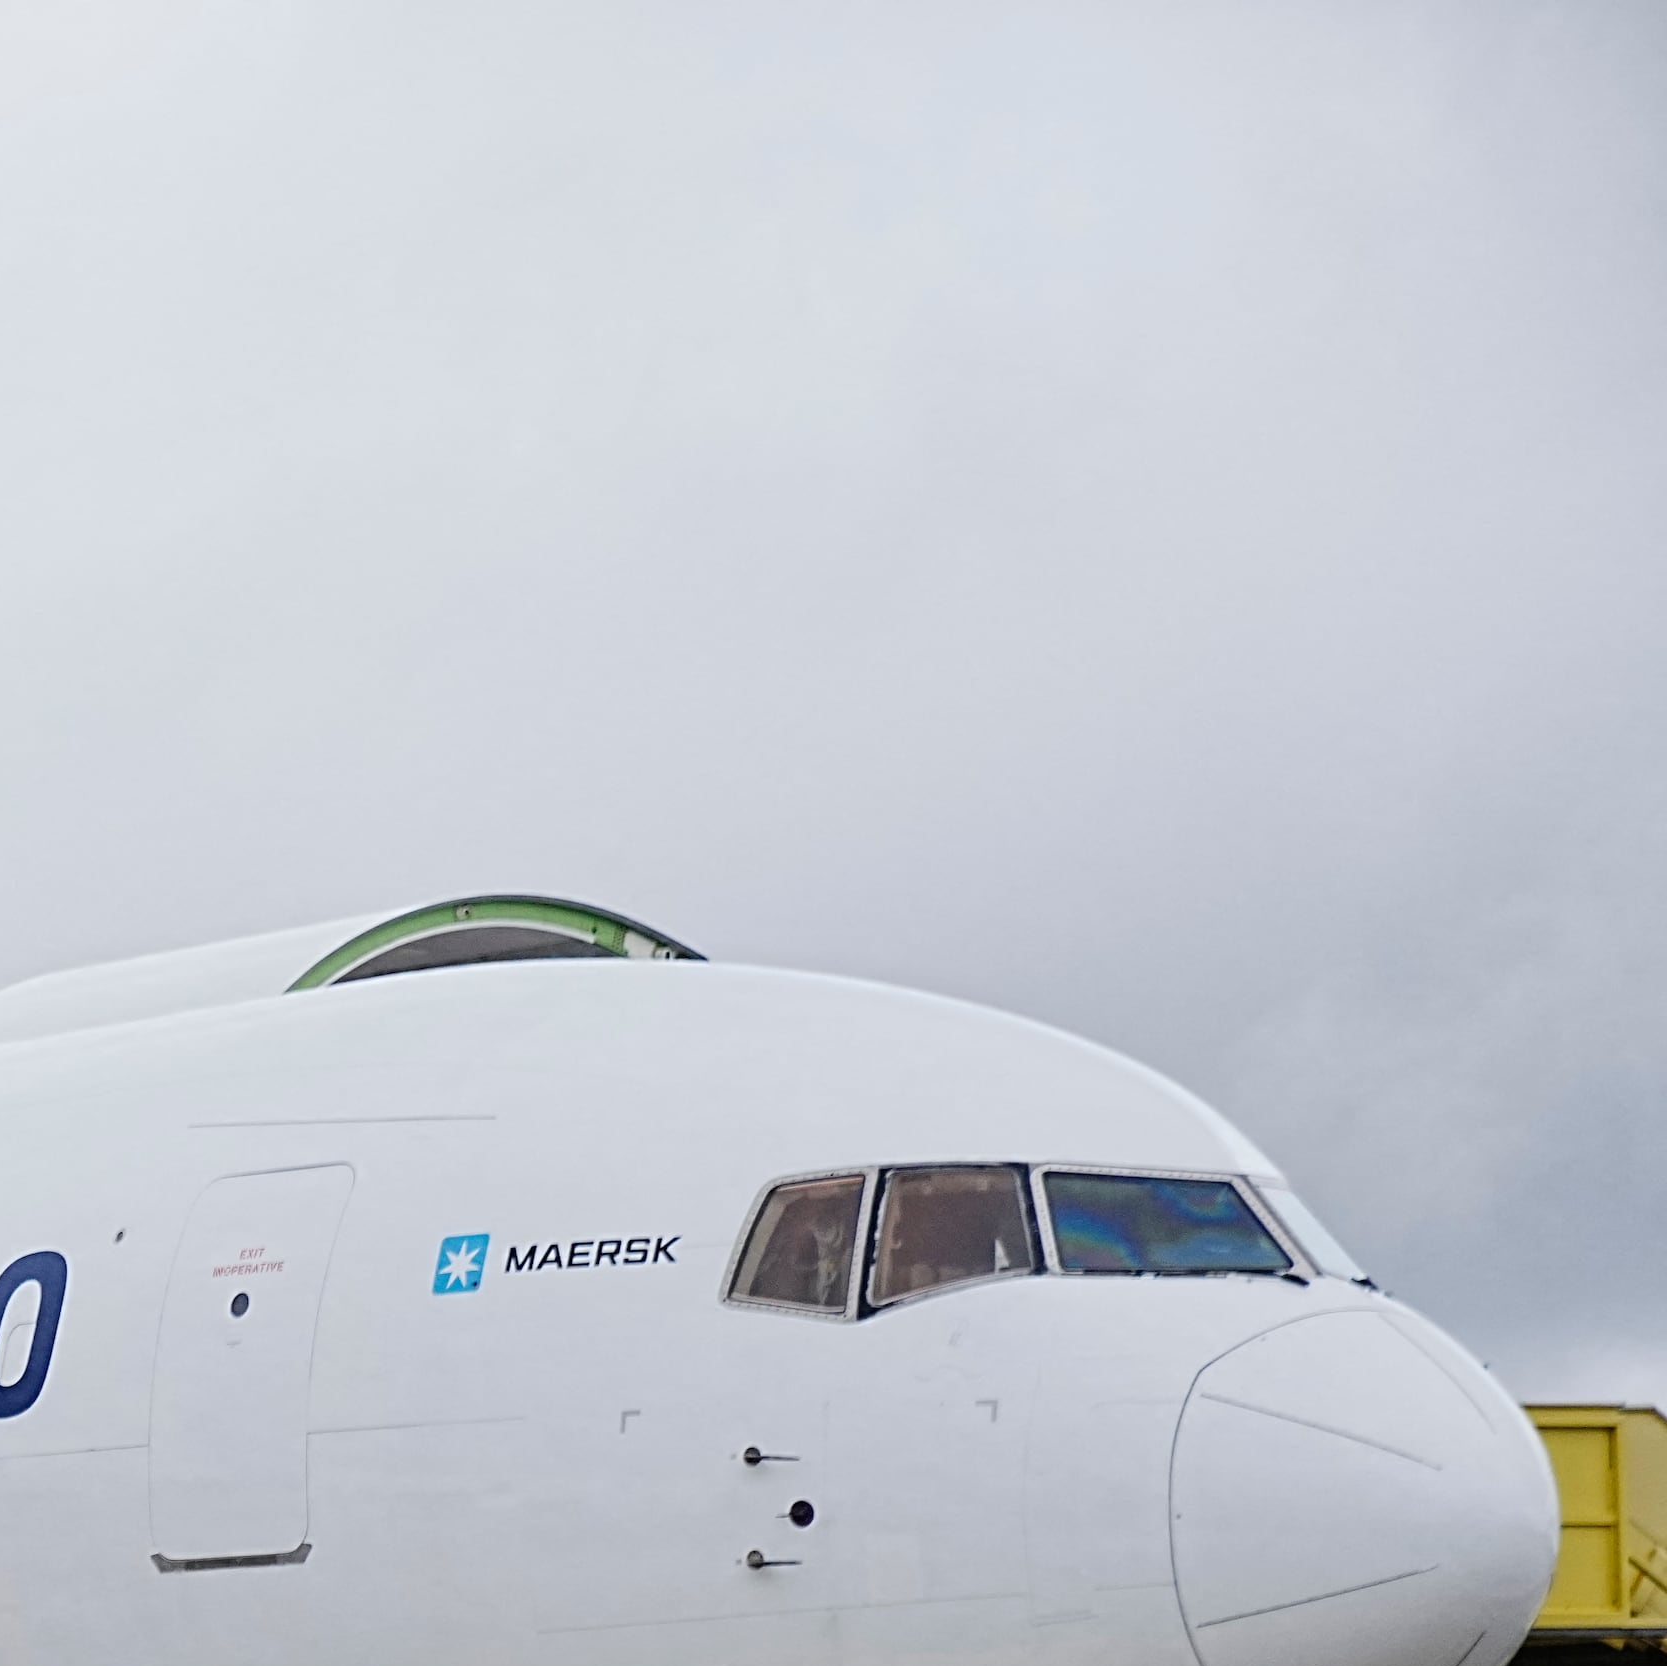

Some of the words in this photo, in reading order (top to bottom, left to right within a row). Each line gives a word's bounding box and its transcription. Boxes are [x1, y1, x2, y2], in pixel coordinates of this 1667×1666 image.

[239, 1248, 265, 1260] EXIT
[504, 1235, 682, 1274] MAERSK
[212, 1262, 284, 1277] INOPERATIVE
